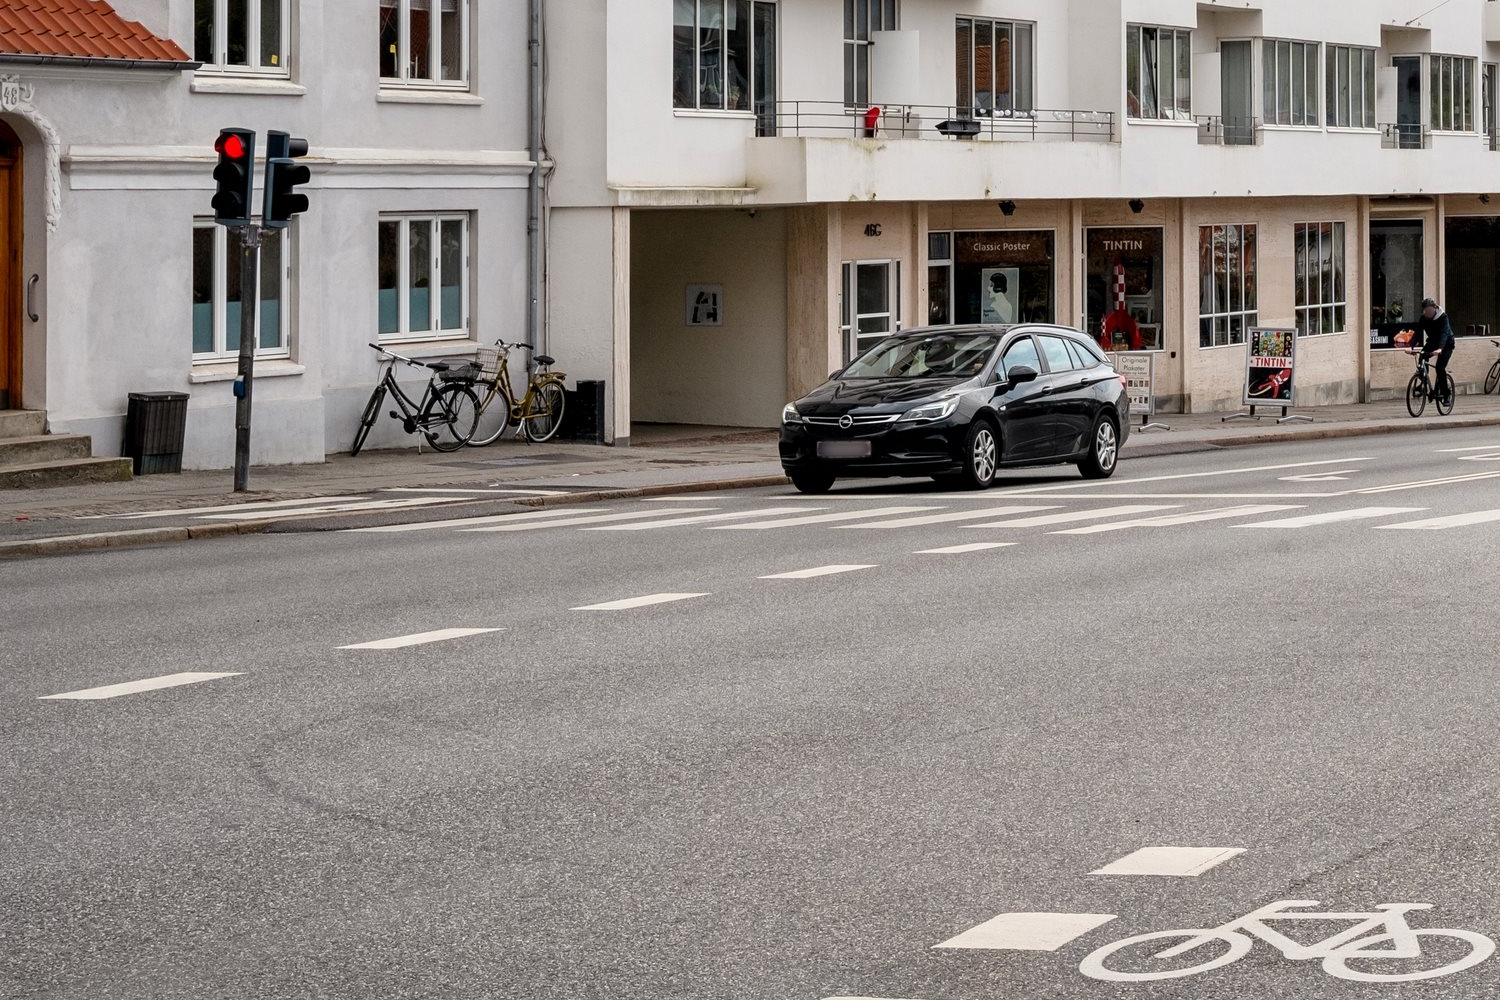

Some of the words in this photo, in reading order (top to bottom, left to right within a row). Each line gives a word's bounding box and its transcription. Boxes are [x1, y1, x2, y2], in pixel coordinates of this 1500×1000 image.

[3, 86, 18, 105] 48
[973, 242, 1001, 251] Classic
[1002, 242, 1031, 251] Poster
[1102, 240, 1143, 250] TINTIN
[1121, 356, 1147, 364] Originale
[1255, 357, 1287, 368] TINTIN
